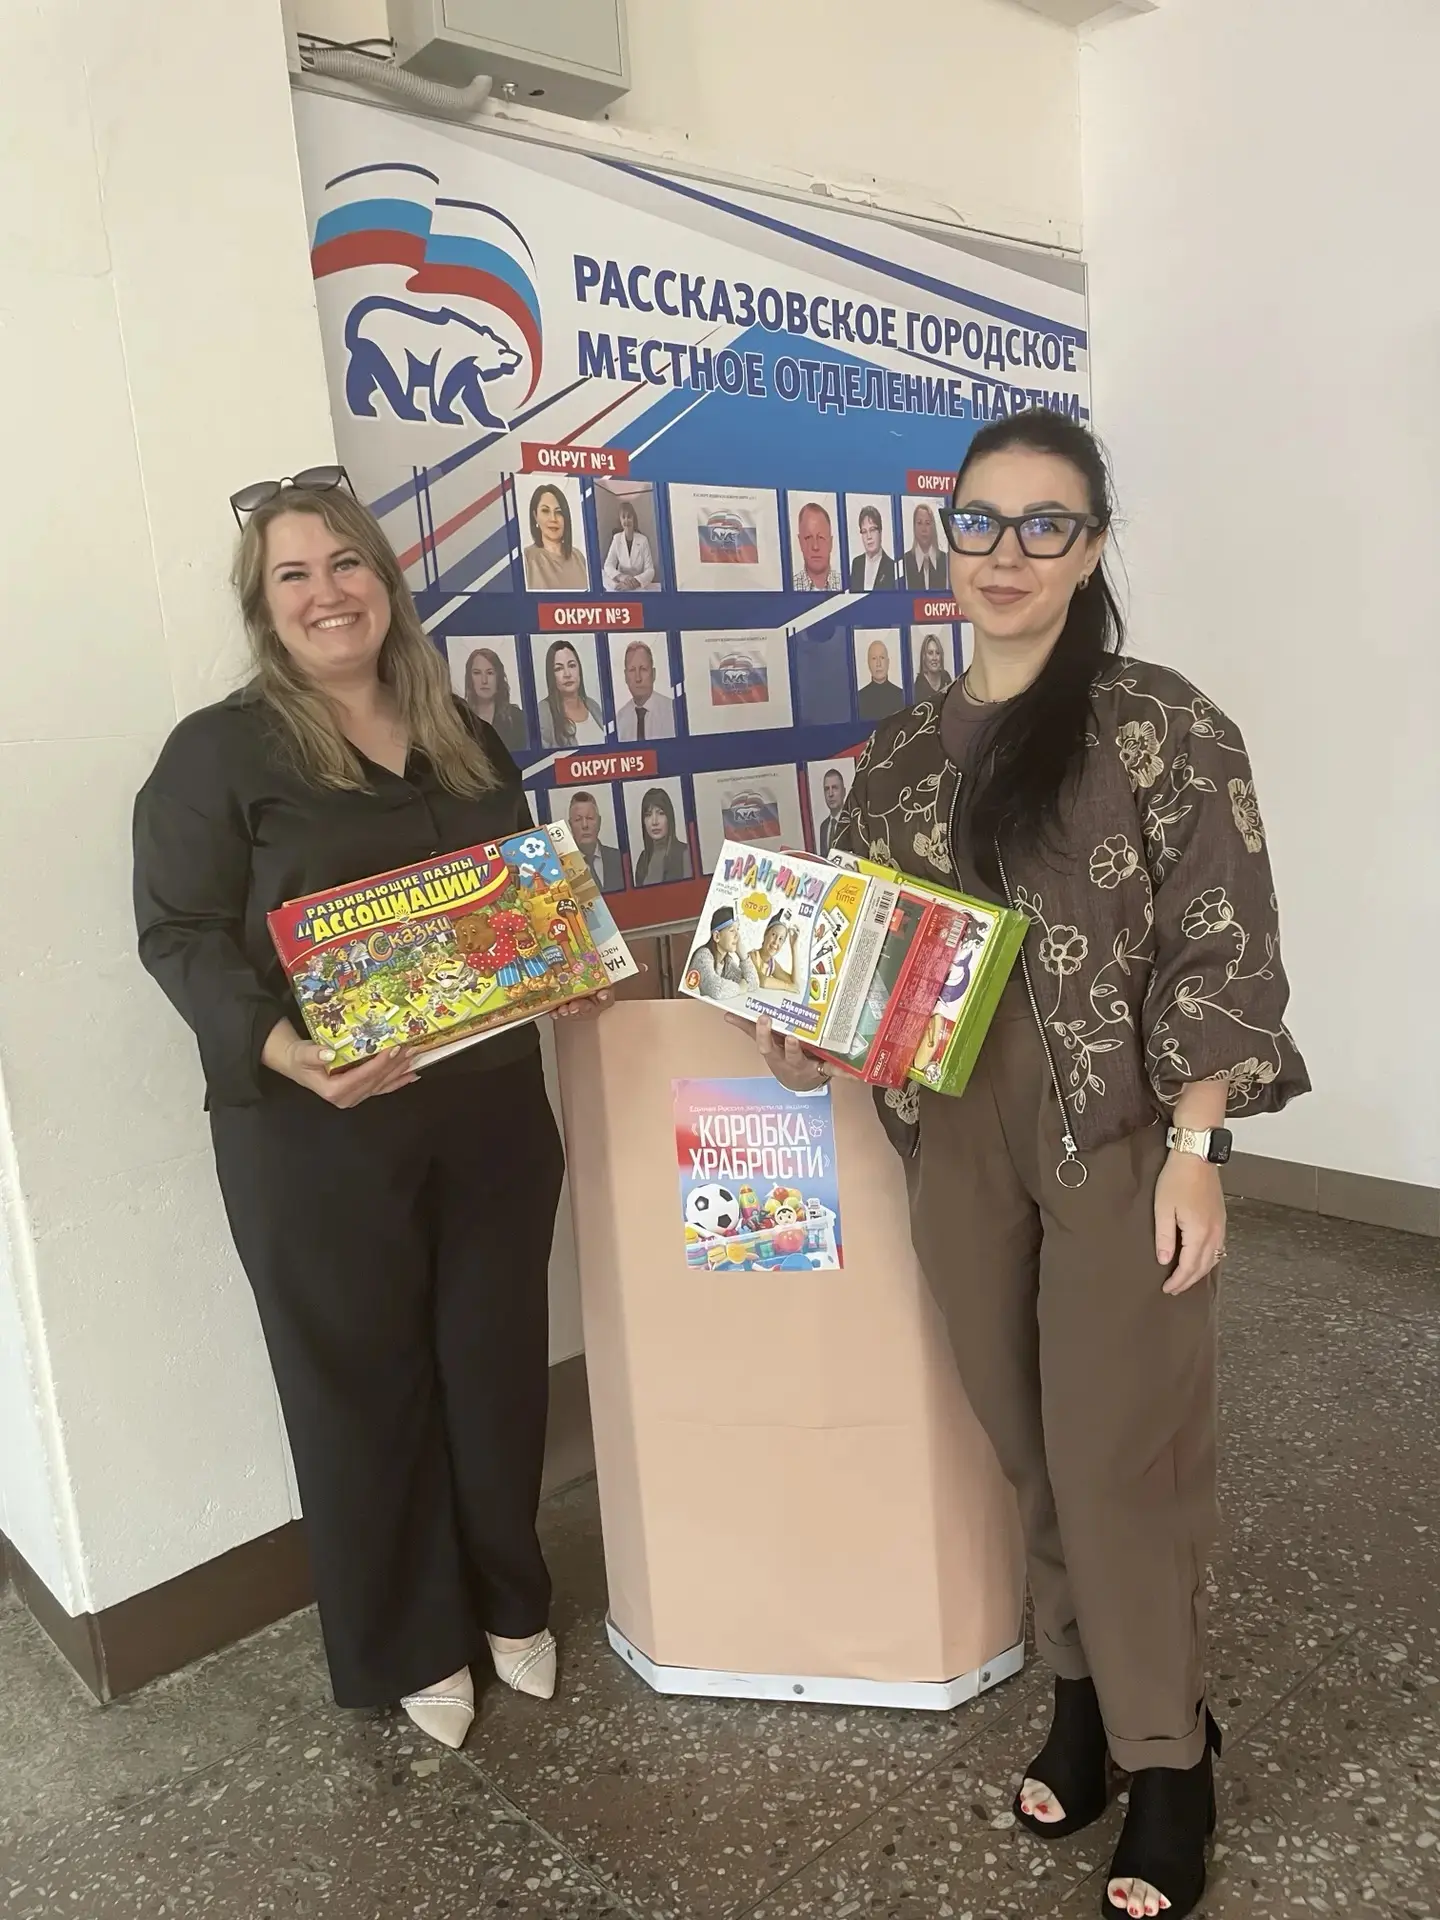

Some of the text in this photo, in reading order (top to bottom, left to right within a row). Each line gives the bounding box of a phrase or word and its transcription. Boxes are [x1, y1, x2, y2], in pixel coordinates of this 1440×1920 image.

[573, 254, 1077, 372] РАССКАЗОВСКОЕ ГОРОДСКОЕ
[578, 330, 766, 397] МЕСТНОЕ
[774, 356, 965, 418] ОТДЕЛЕНИЕ
[538, 449, 616, 470] ОКРУГ №1
[917, 475, 950, 490] ОКРУГ
[554, 608, 631, 625] ОКРУГ №3
[924, 603, 957, 616] ОКРУГ
[570, 756, 645, 778] ОКРУГ №5
[550, 829, 561, 838] 5+
[526, 843, 541, 854] 3+
[724, 854, 826, 903] ТАРАНТИНКИ
[306, 858, 473, 919] РАЗВИВАЮЩИЕ ПАЗЛЫ
[836, 892, 855, 905] time
[800, 904, 813, 915] 10+
[367, 916, 450, 962] Сказки
[600, 946, 619, 958] наст
